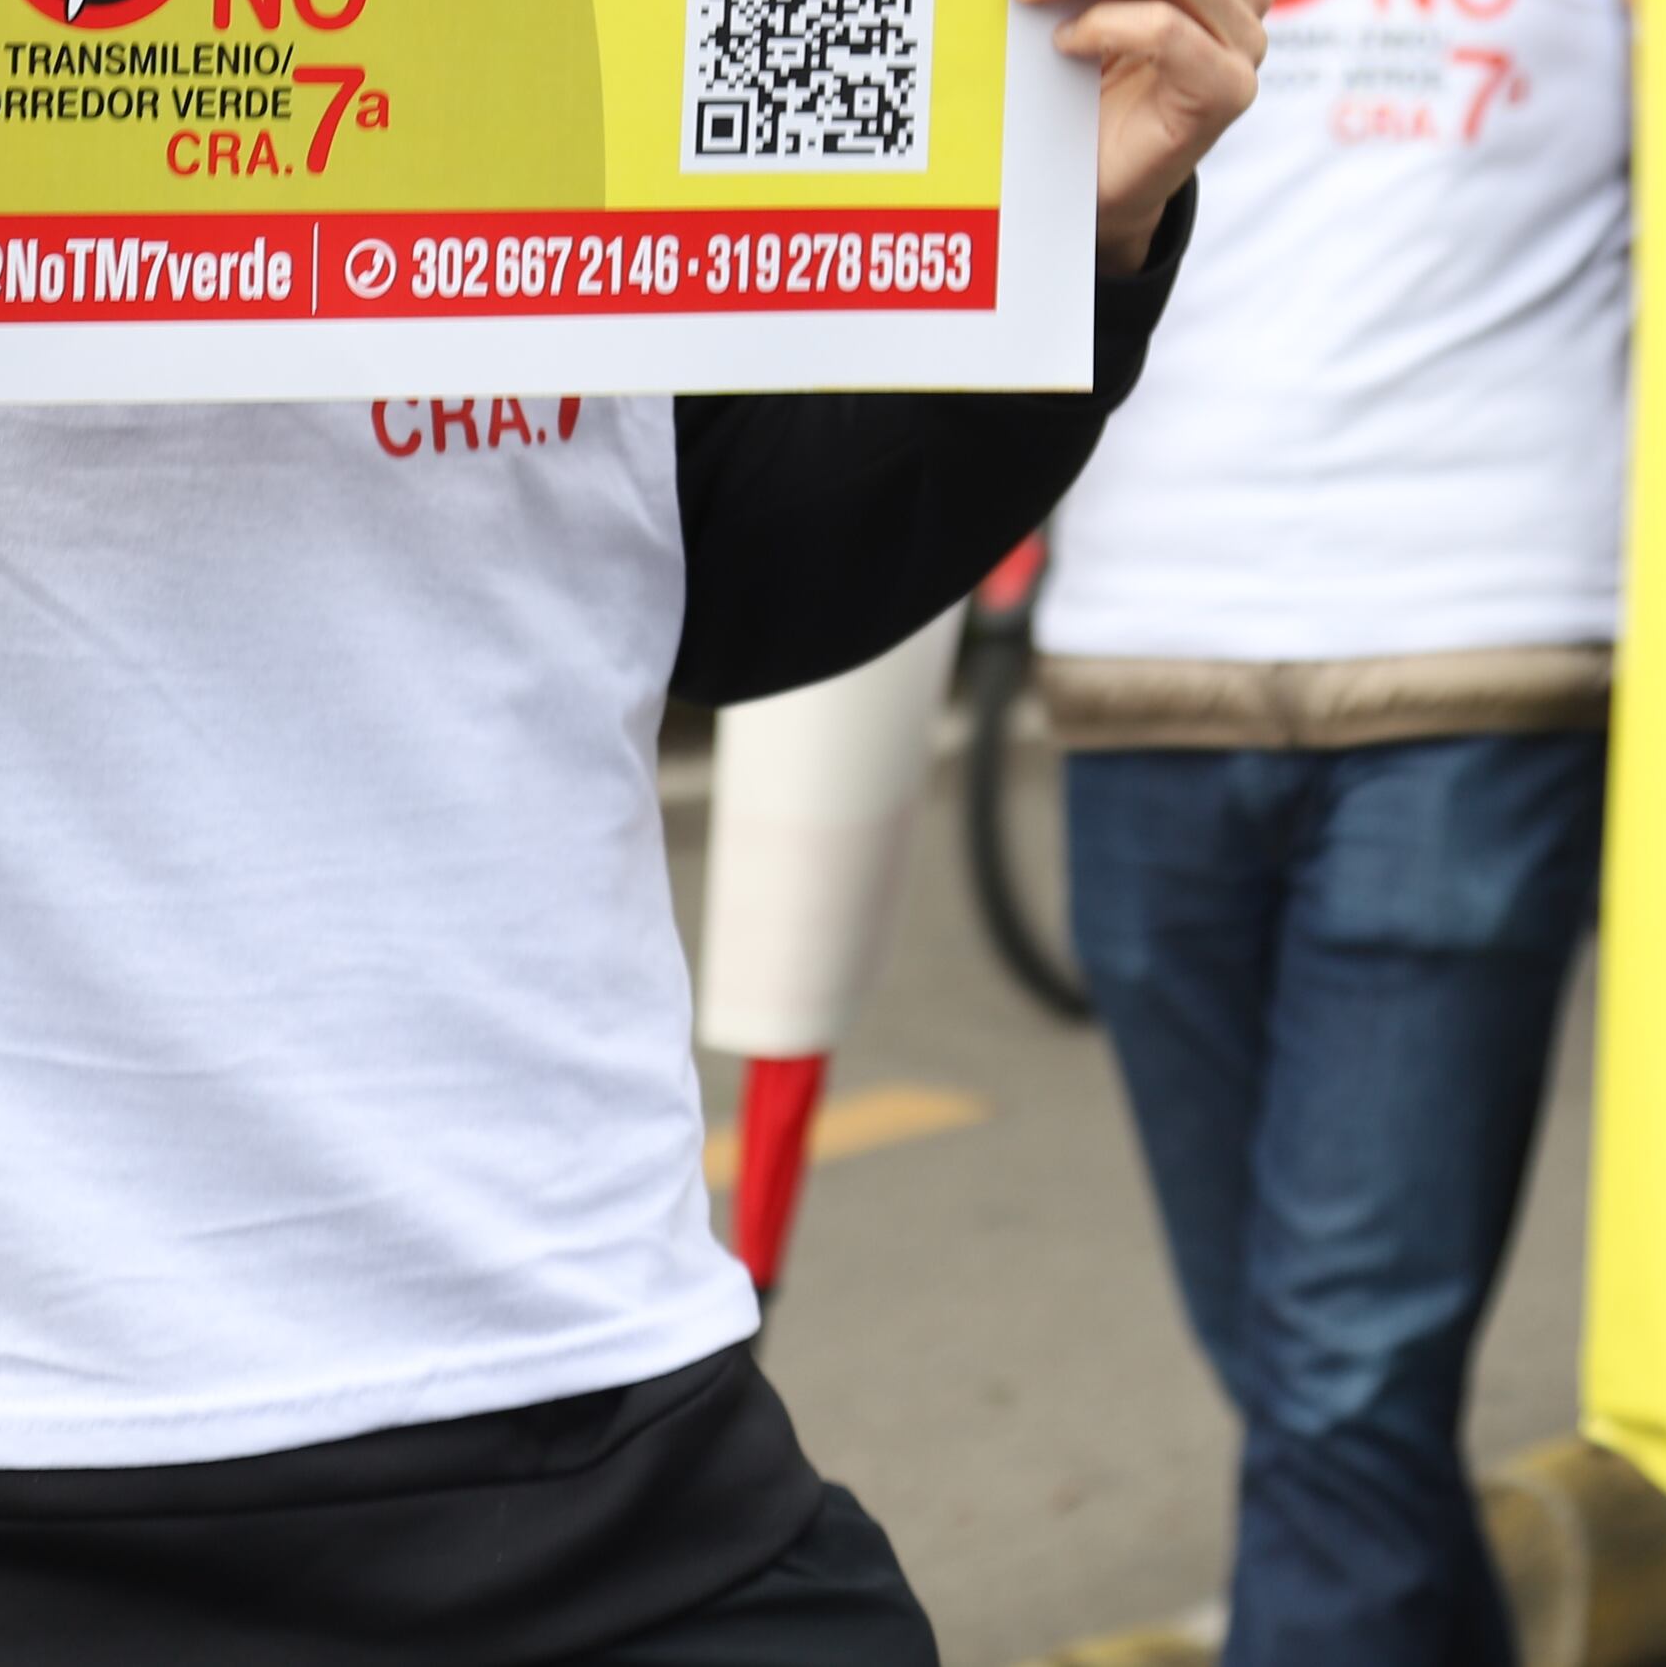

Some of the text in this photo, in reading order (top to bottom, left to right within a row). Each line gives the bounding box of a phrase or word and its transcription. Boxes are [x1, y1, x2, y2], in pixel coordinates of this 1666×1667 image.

[4, 40, 294, 78] TRANSMILENIO/
[172, 85, 293, 121] VERDE
[165, 128, 294, 179] CRA.
